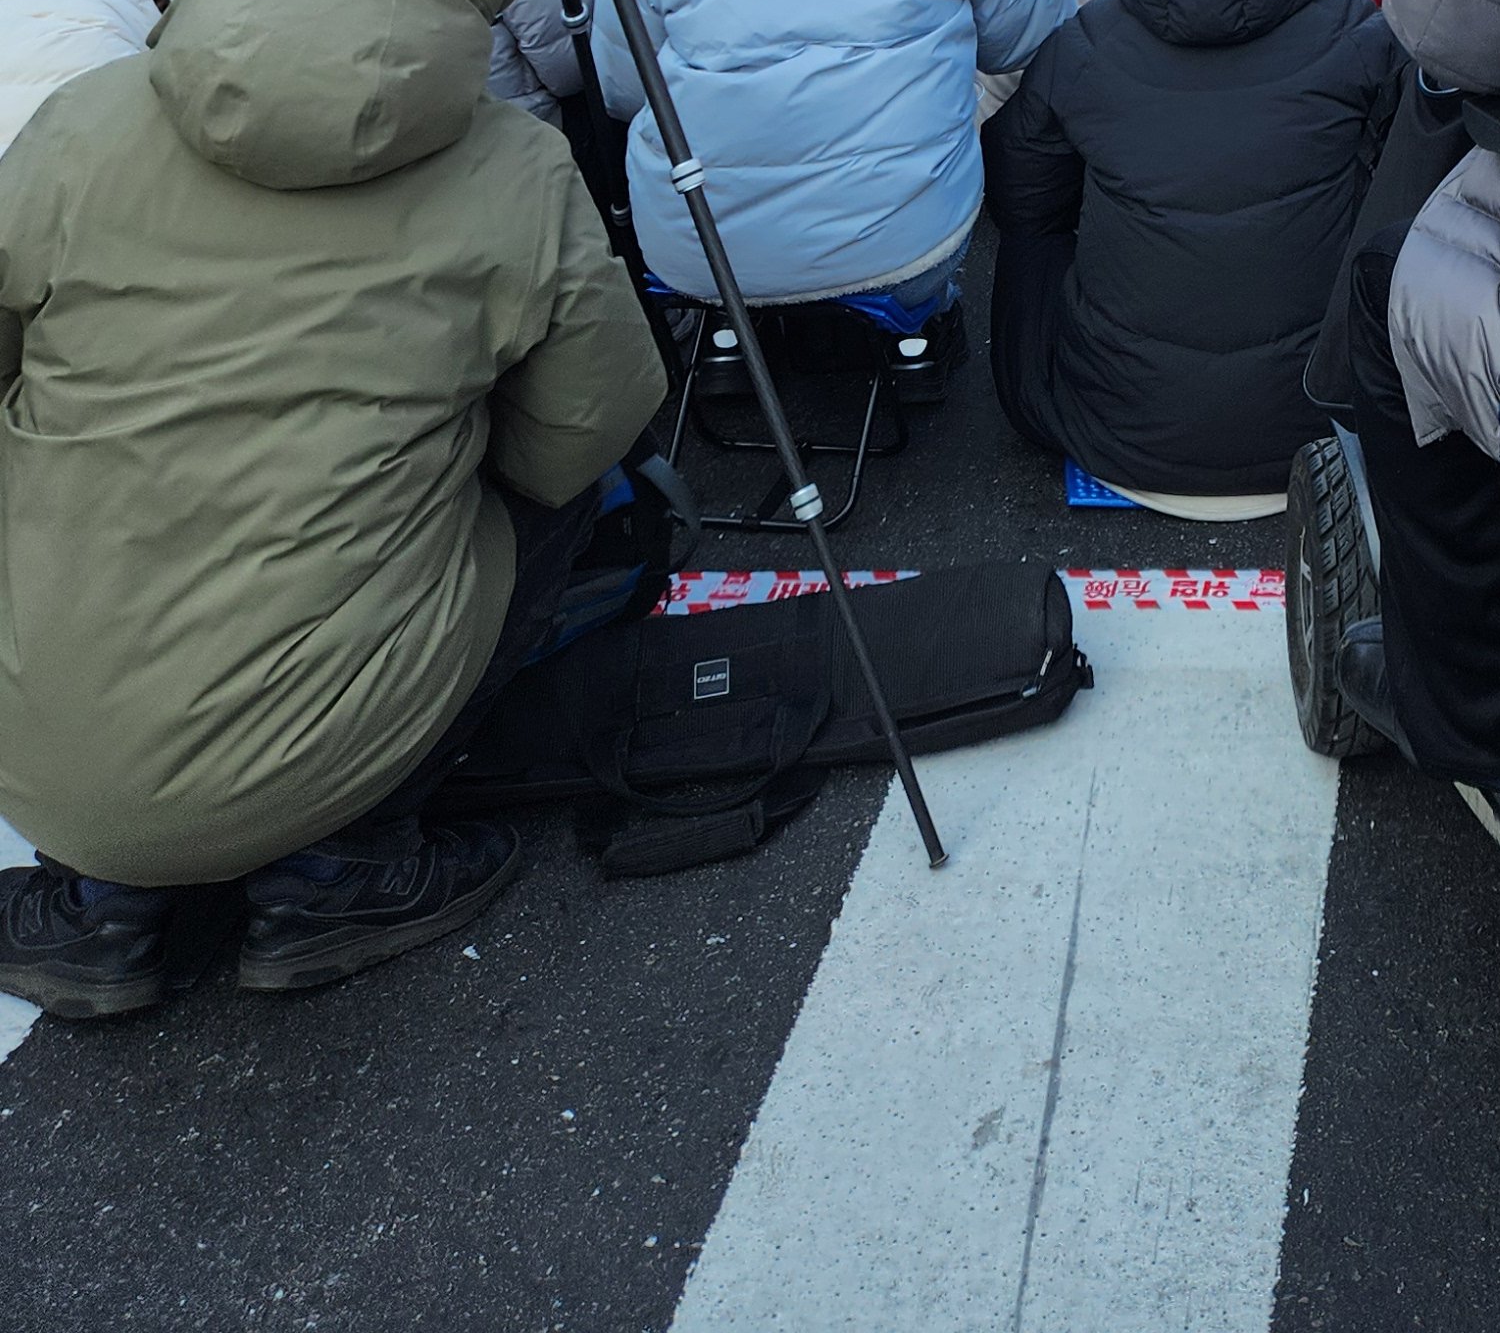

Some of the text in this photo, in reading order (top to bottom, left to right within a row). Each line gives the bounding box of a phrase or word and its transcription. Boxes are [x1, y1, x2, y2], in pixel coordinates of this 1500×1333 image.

[1083, 577, 1231, 601] 위험 危險
[696, 672, 727, 684] GITZO
